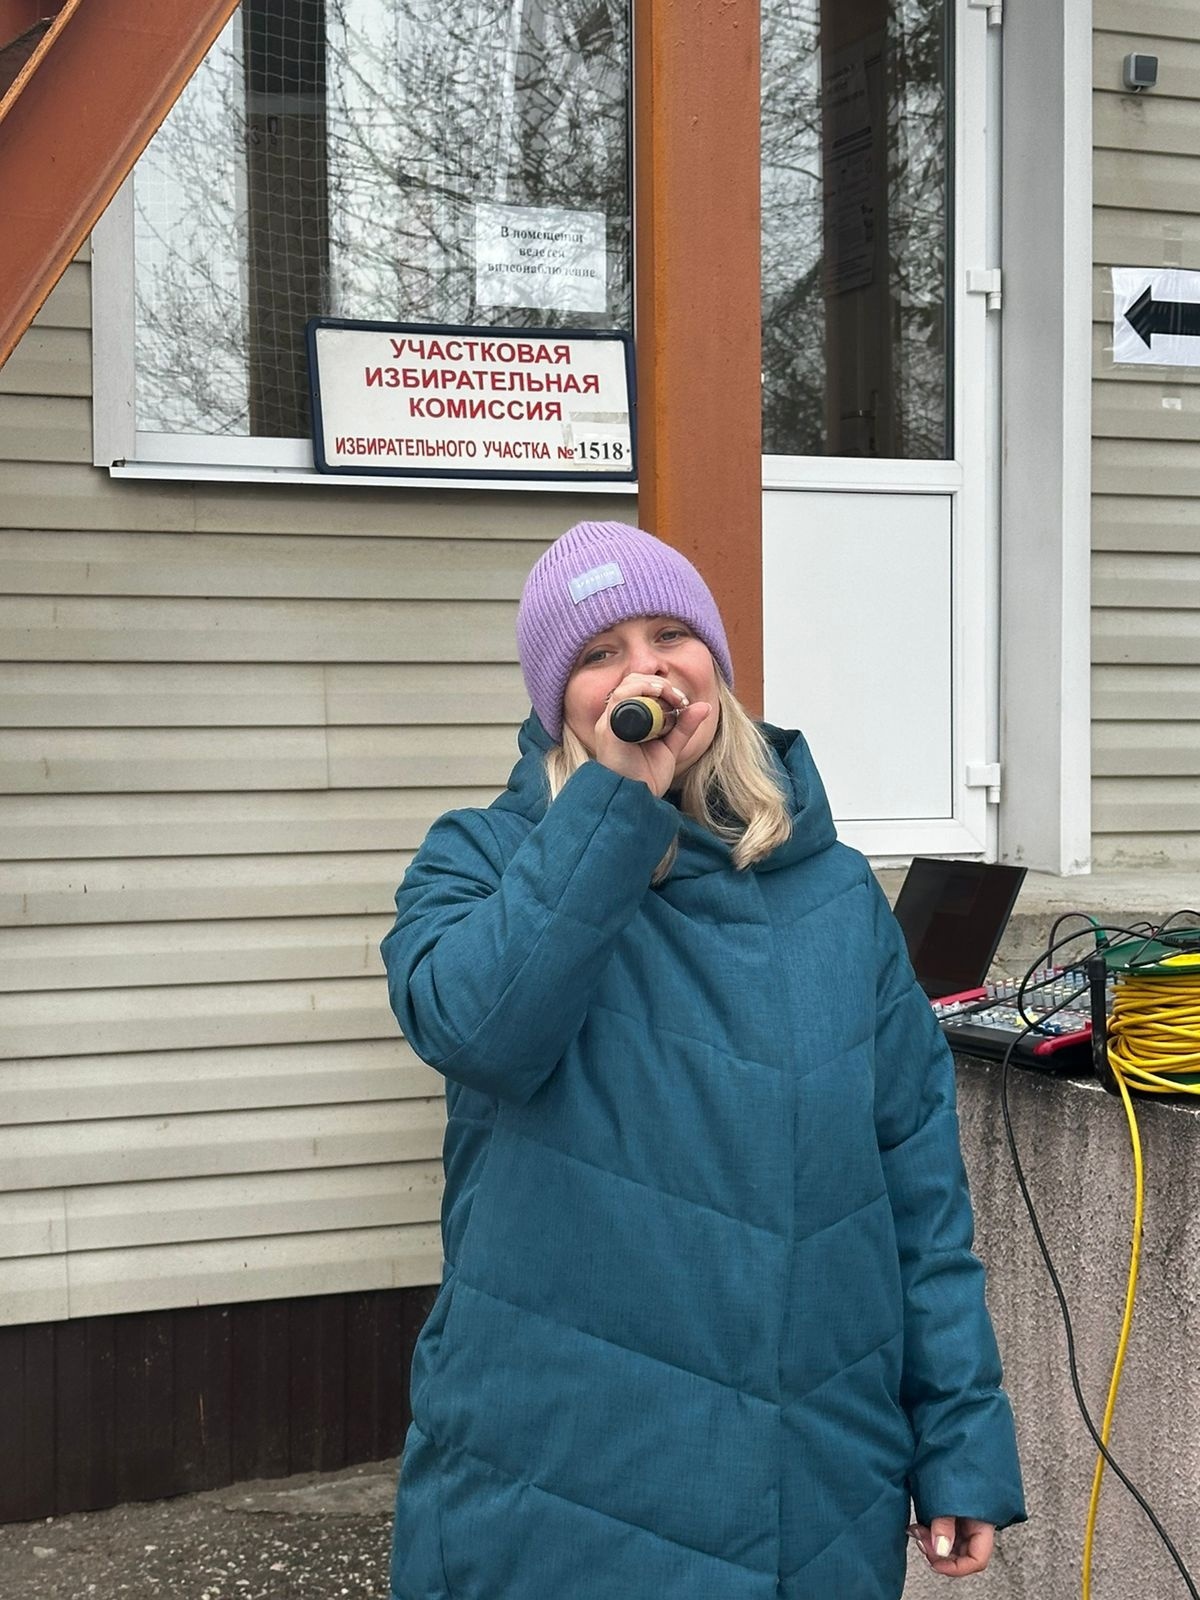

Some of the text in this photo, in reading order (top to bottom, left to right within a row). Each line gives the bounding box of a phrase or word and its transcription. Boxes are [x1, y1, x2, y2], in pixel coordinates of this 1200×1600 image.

[501, 226, 510, 238] В
[389, 338, 571, 365] УЧАСТКОВАЯ
[365, 366, 600, 394] ИЗБИРАТЕЛЬНАЯ
[409, 397, 562, 421] КОМИССИЯ
[335, 436, 477, 458] ИЗБИРАТЕЛЬНОГО
[483, 440, 551, 459] УЧАСТКА
